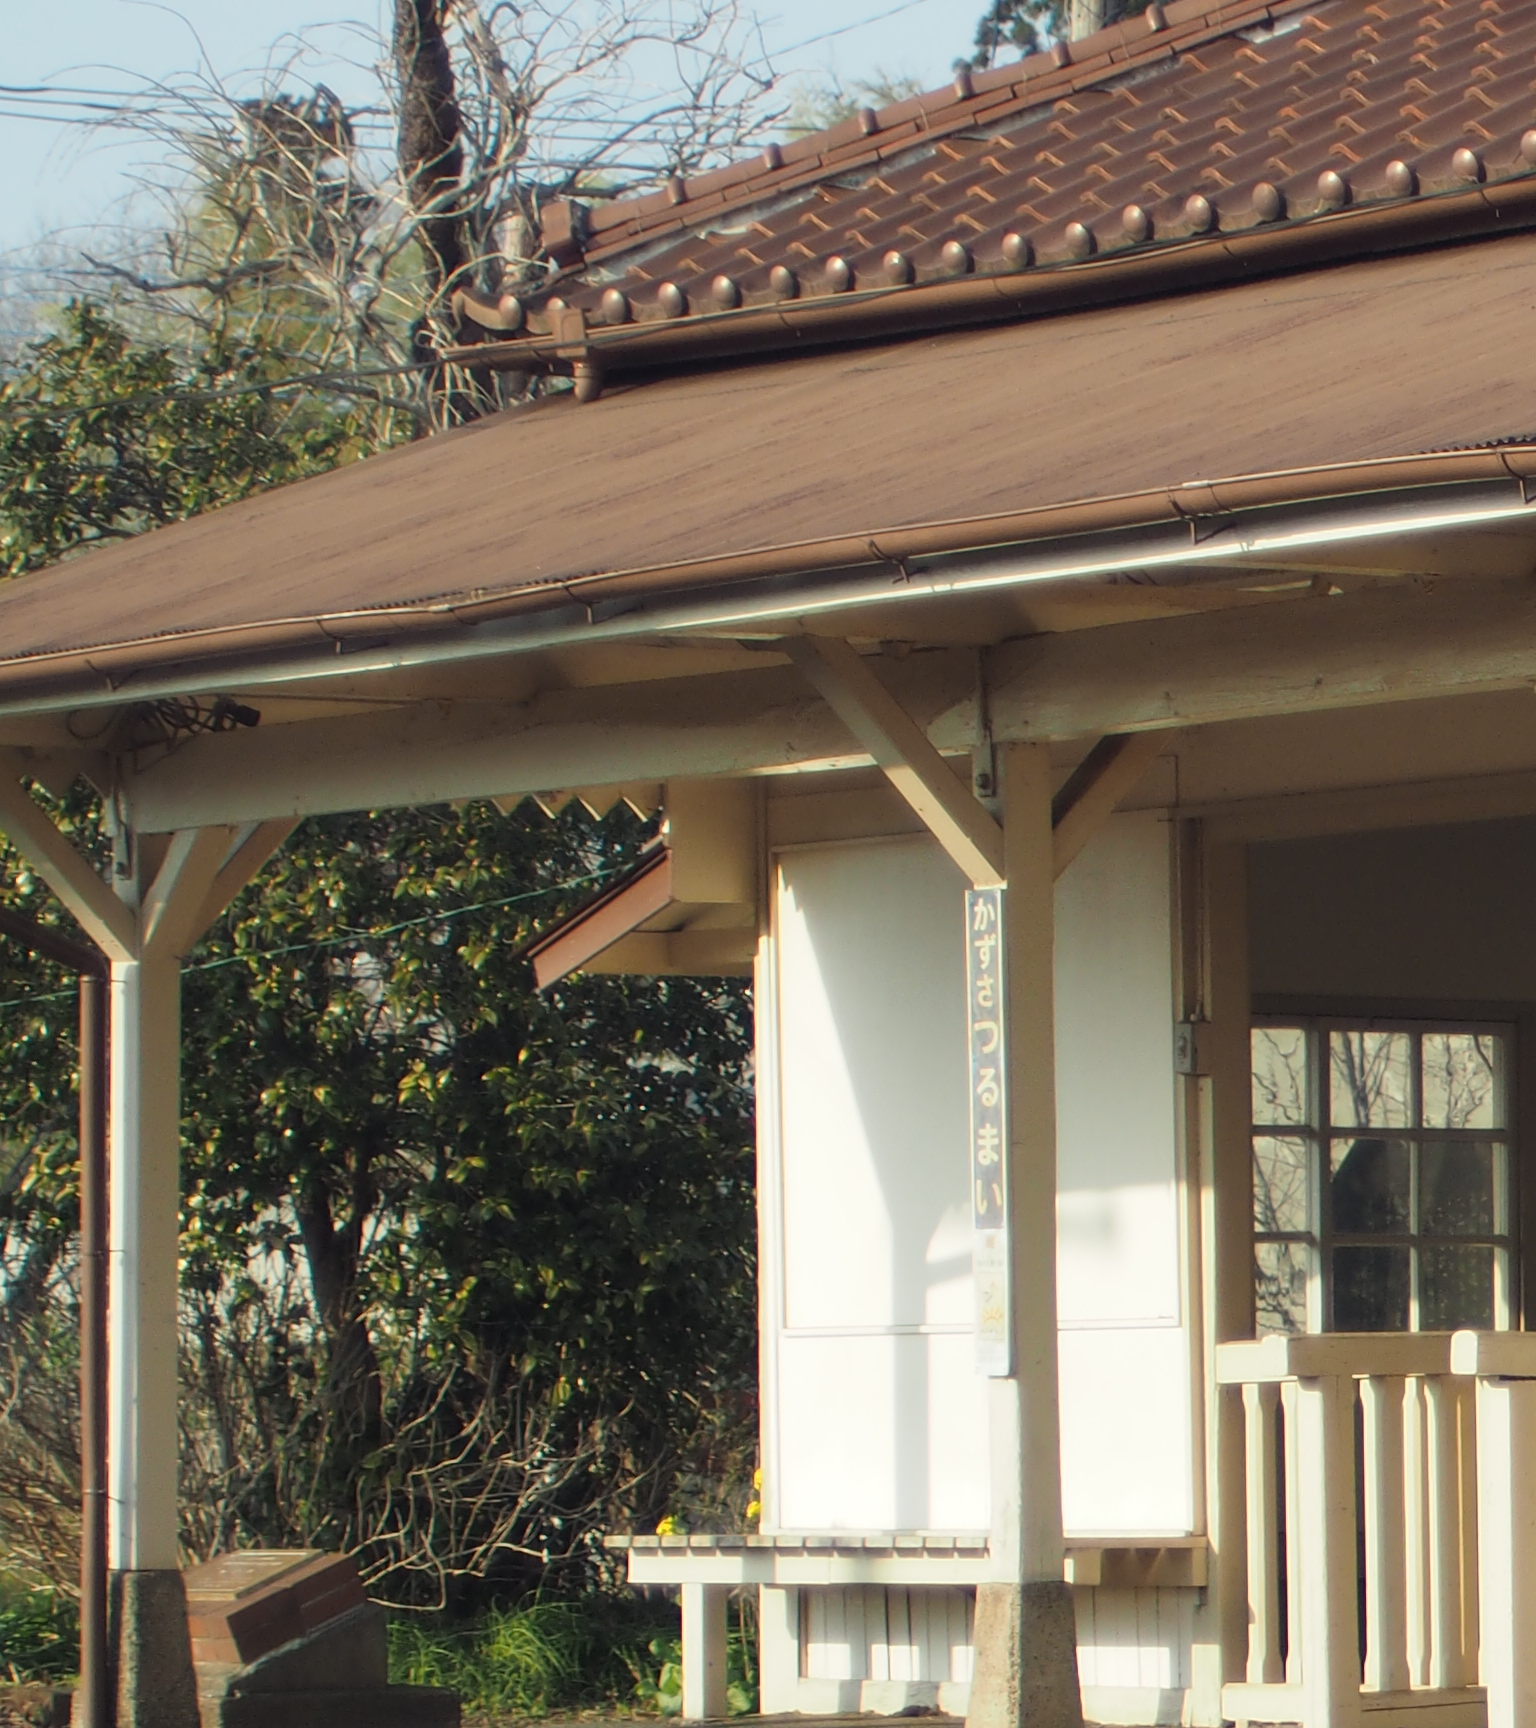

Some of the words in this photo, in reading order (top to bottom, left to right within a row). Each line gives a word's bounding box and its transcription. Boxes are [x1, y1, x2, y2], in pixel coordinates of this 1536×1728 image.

[973, 898, 1003, 1215] かずさつるまい
